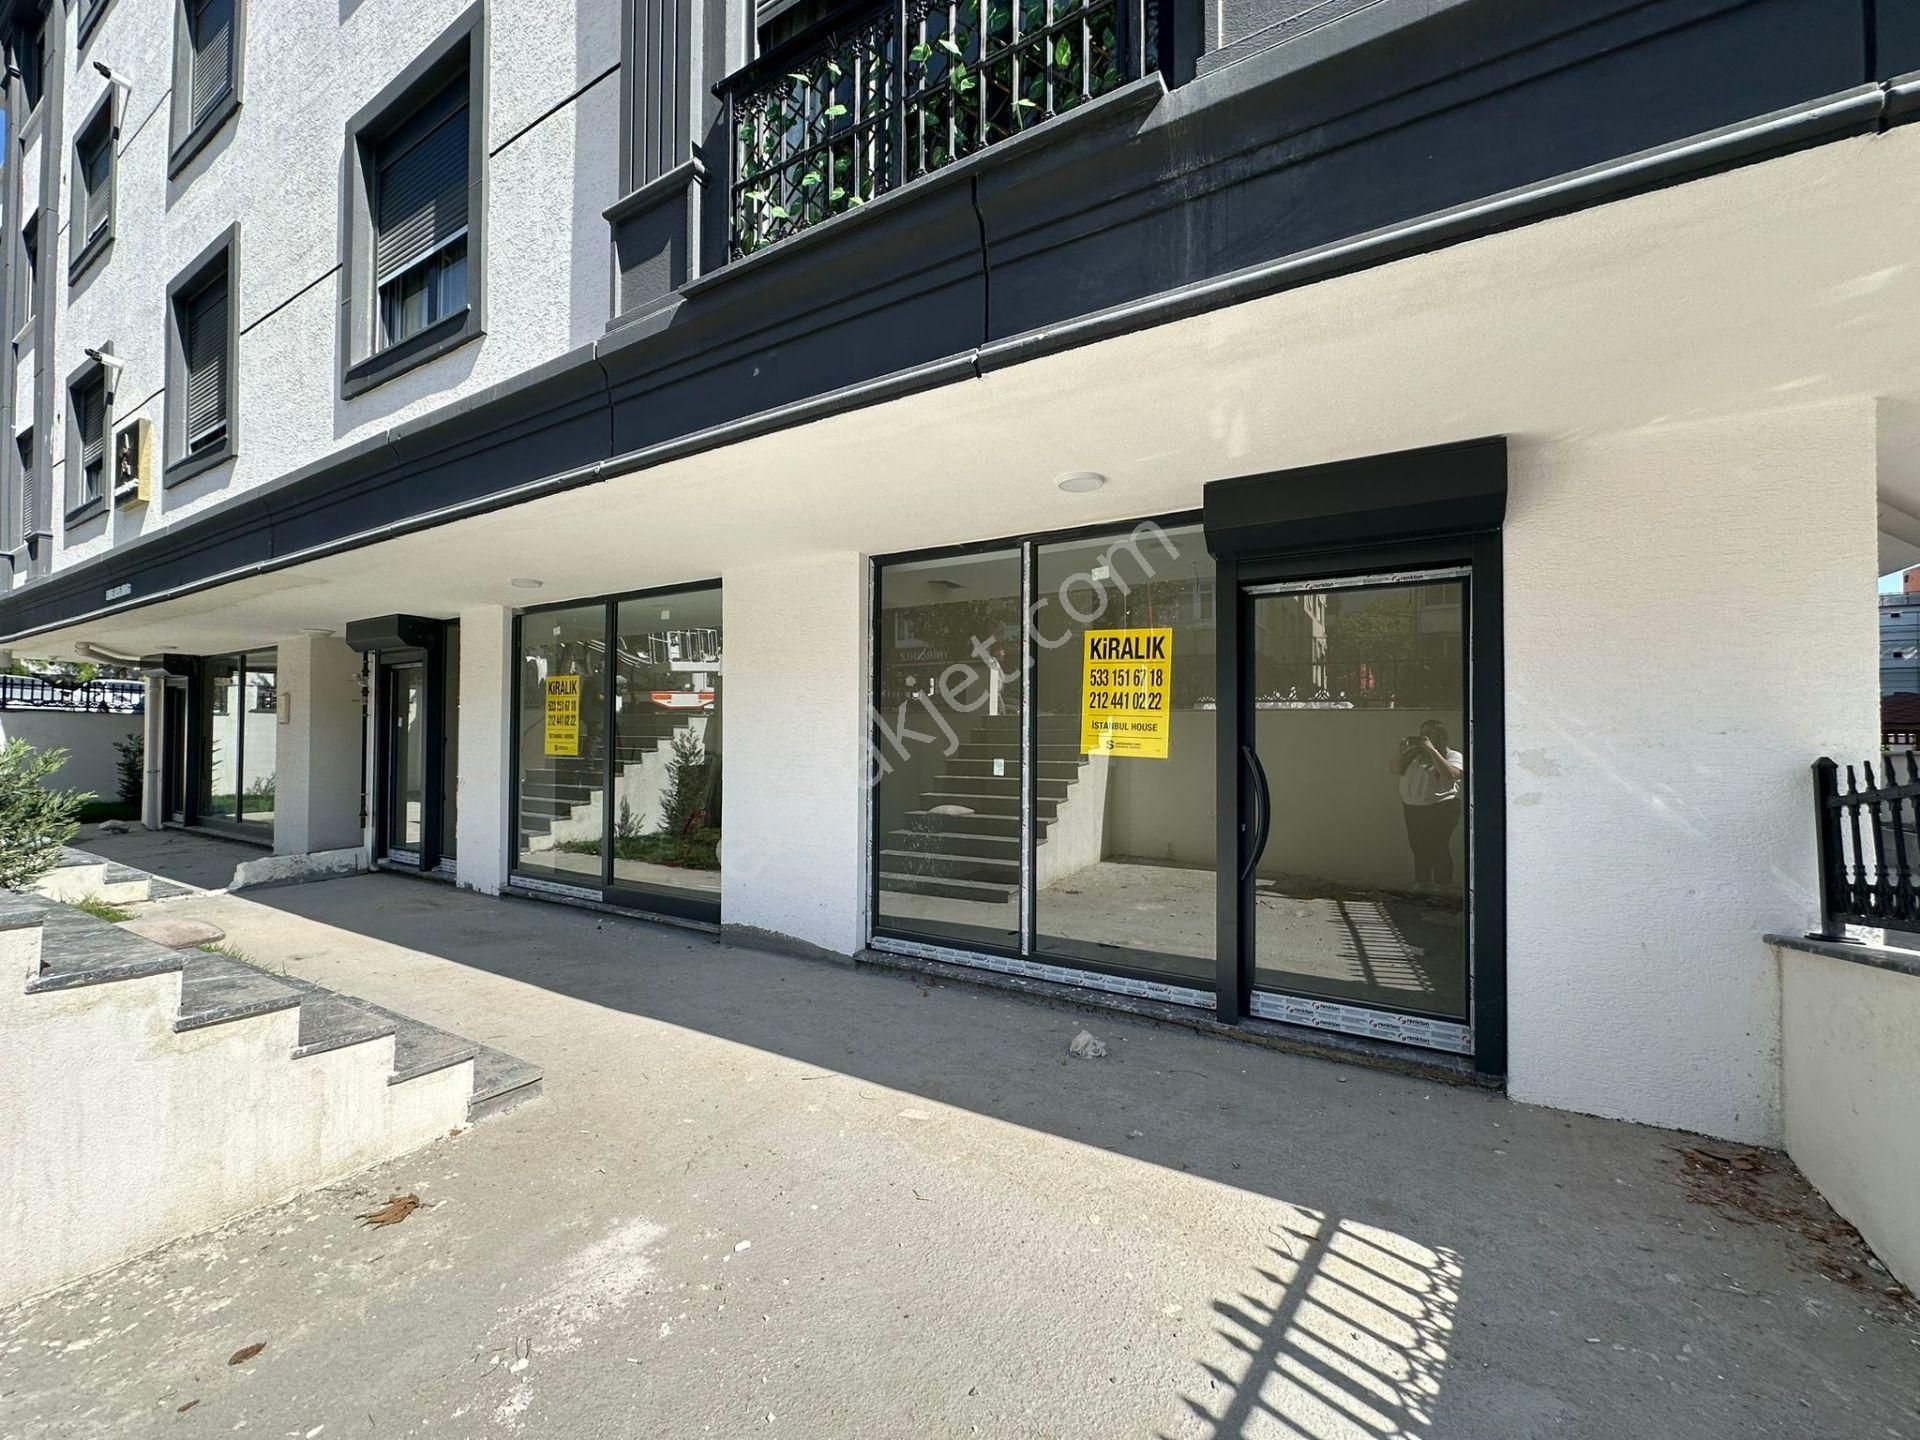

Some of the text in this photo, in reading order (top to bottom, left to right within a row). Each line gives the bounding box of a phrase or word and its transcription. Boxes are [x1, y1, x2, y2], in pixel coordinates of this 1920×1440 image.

[1090, 669, 1163, 686] 533 151 67 18
[1089, 692, 1162, 710] 212 441 02 22
[1131, 722, 1158, 732] HOUSE
[1320, 1003, 1341, 1012] renkton
[1377, 1022, 1400, 1030] renkton
[1406, 1018, 1430, 1027] renkton
[1406, 1035, 1430, 1044] renkton
